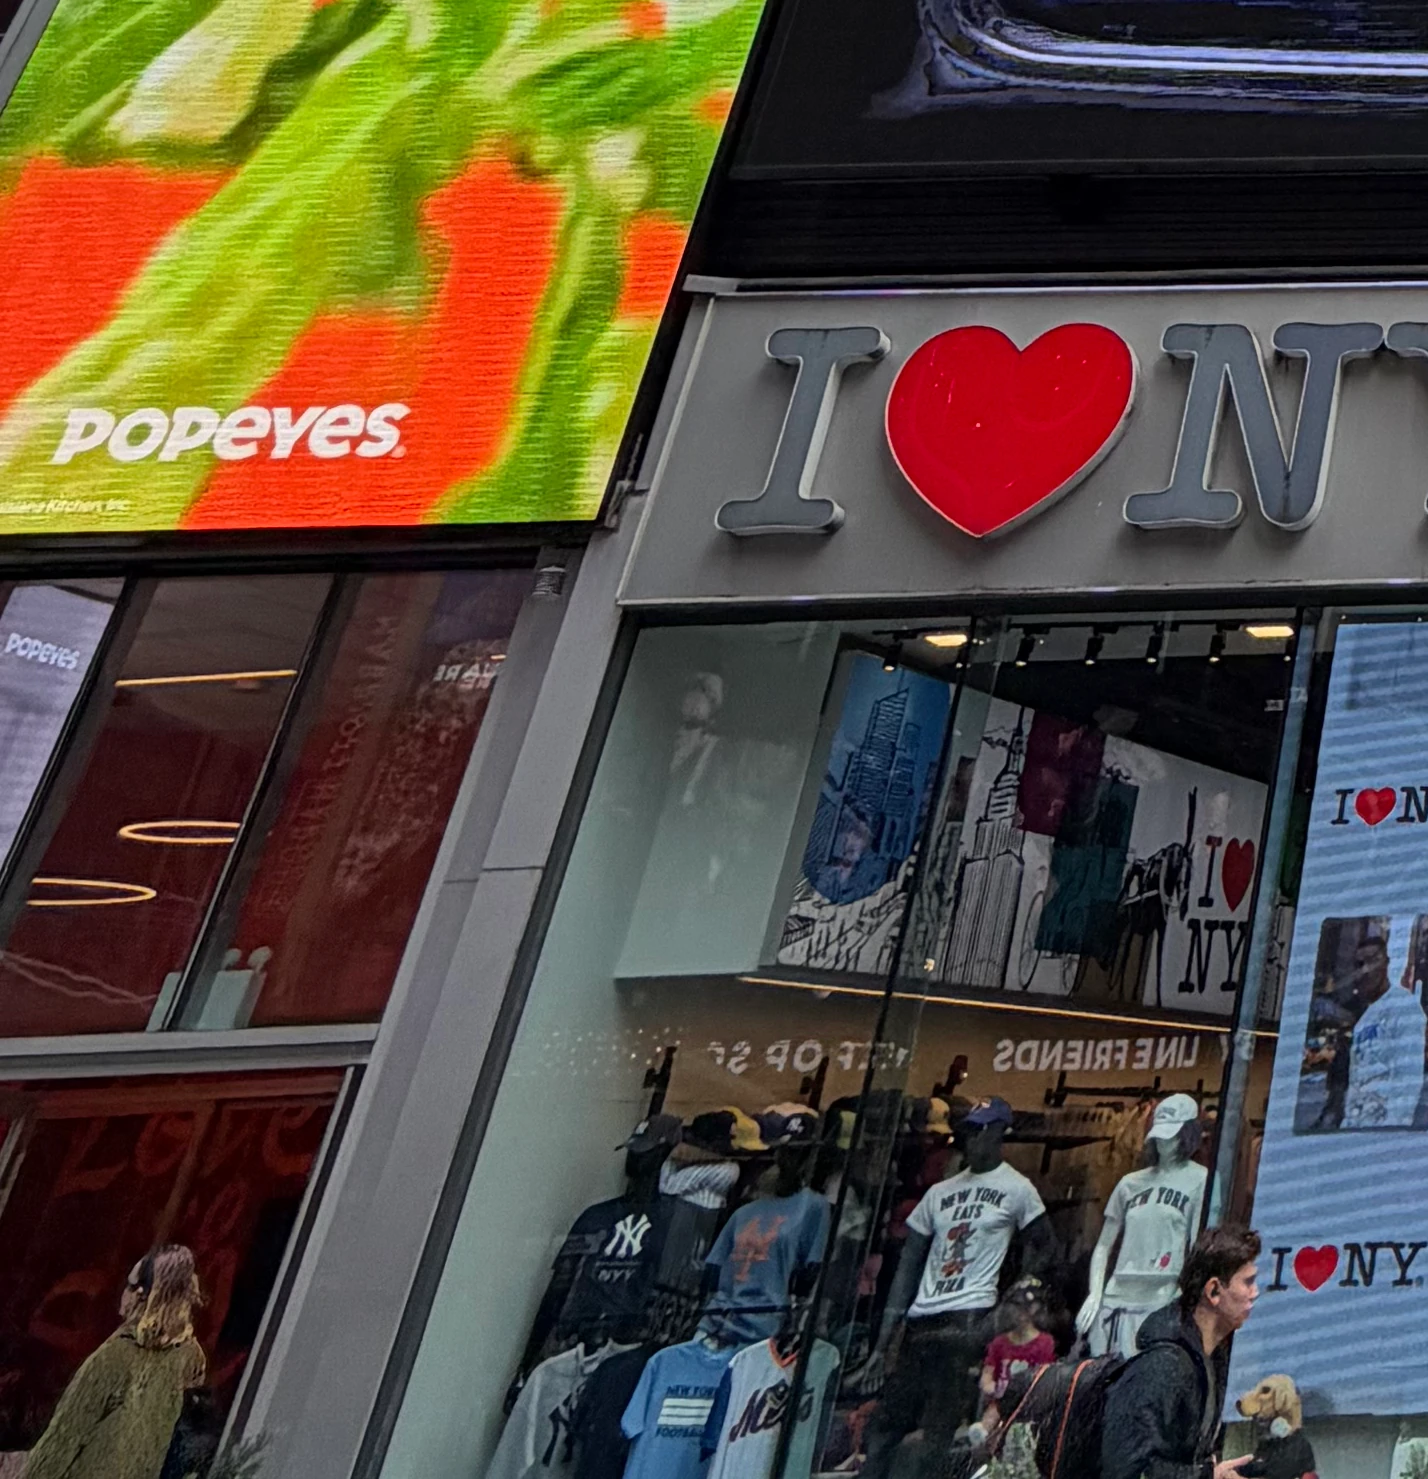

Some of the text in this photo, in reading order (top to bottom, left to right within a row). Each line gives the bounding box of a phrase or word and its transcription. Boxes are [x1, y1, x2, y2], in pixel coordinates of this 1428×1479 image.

[714, 324, 893, 537] I
[1329, 787, 1355, 825] I
[1198, 835, 1223, 909] I
[1176, 918, 1250, 994] NY
[940, 1185, 1009, 1213] NEW YORK
[951, 1203, 985, 1222] EATS
[1155, 1185, 1192, 1214] YORK
[603, 1213, 653, 1258] NY
[1266, 1240, 1428, 1292] I NY
